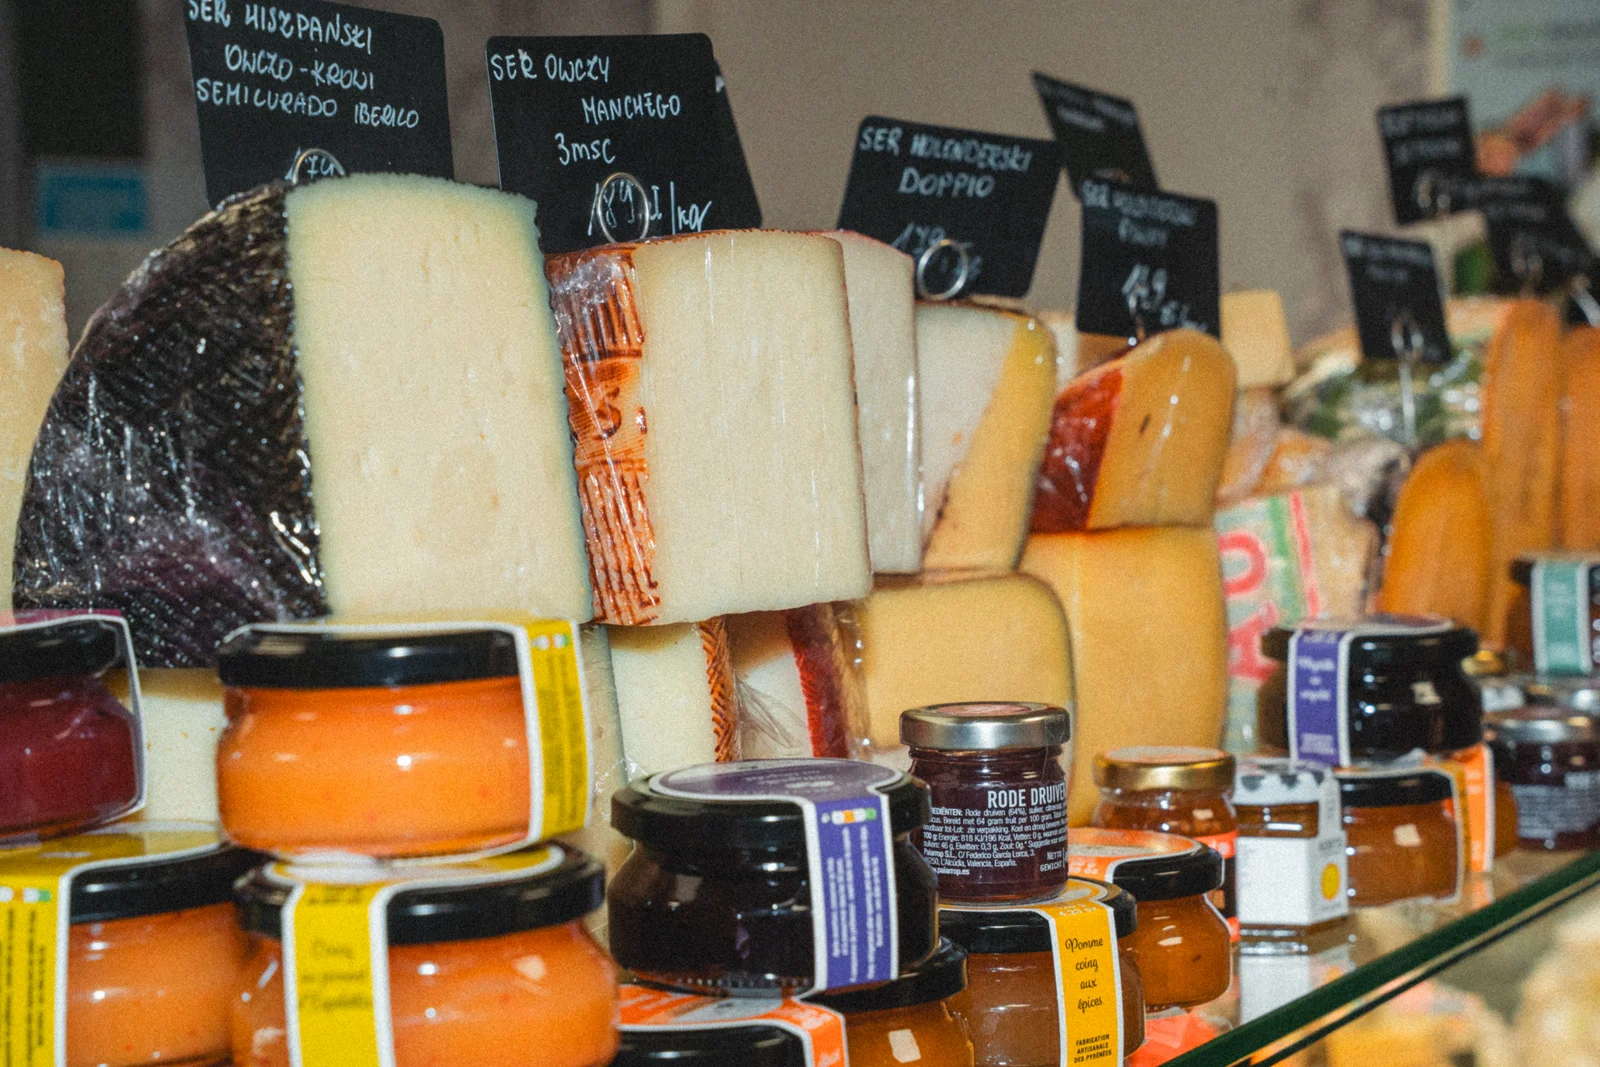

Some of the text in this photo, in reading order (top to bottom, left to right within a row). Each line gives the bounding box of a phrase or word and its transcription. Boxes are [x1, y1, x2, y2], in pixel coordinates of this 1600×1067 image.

[490, 53, 610, 83] SER OWCZY
[581, 92, 681, 125] MANCHEGO
[859, 126, 904, 156] SER
[988, 790, 1027, 809] RODE
[984, 809, 1006, 817] druiven
[1065, 937, 1103, 952] Pomme
[1075, 957, 1099, 972] coing
[1080, 978, 1098, 990] aux
[1077, 996, 1103, 1013] épices
[1076, 1034, 1110, 1047] FABRICATION
[1077, 1042, 1109, 1054] ARTISANALE
[1073, 1055, 1085, 1063] DES
